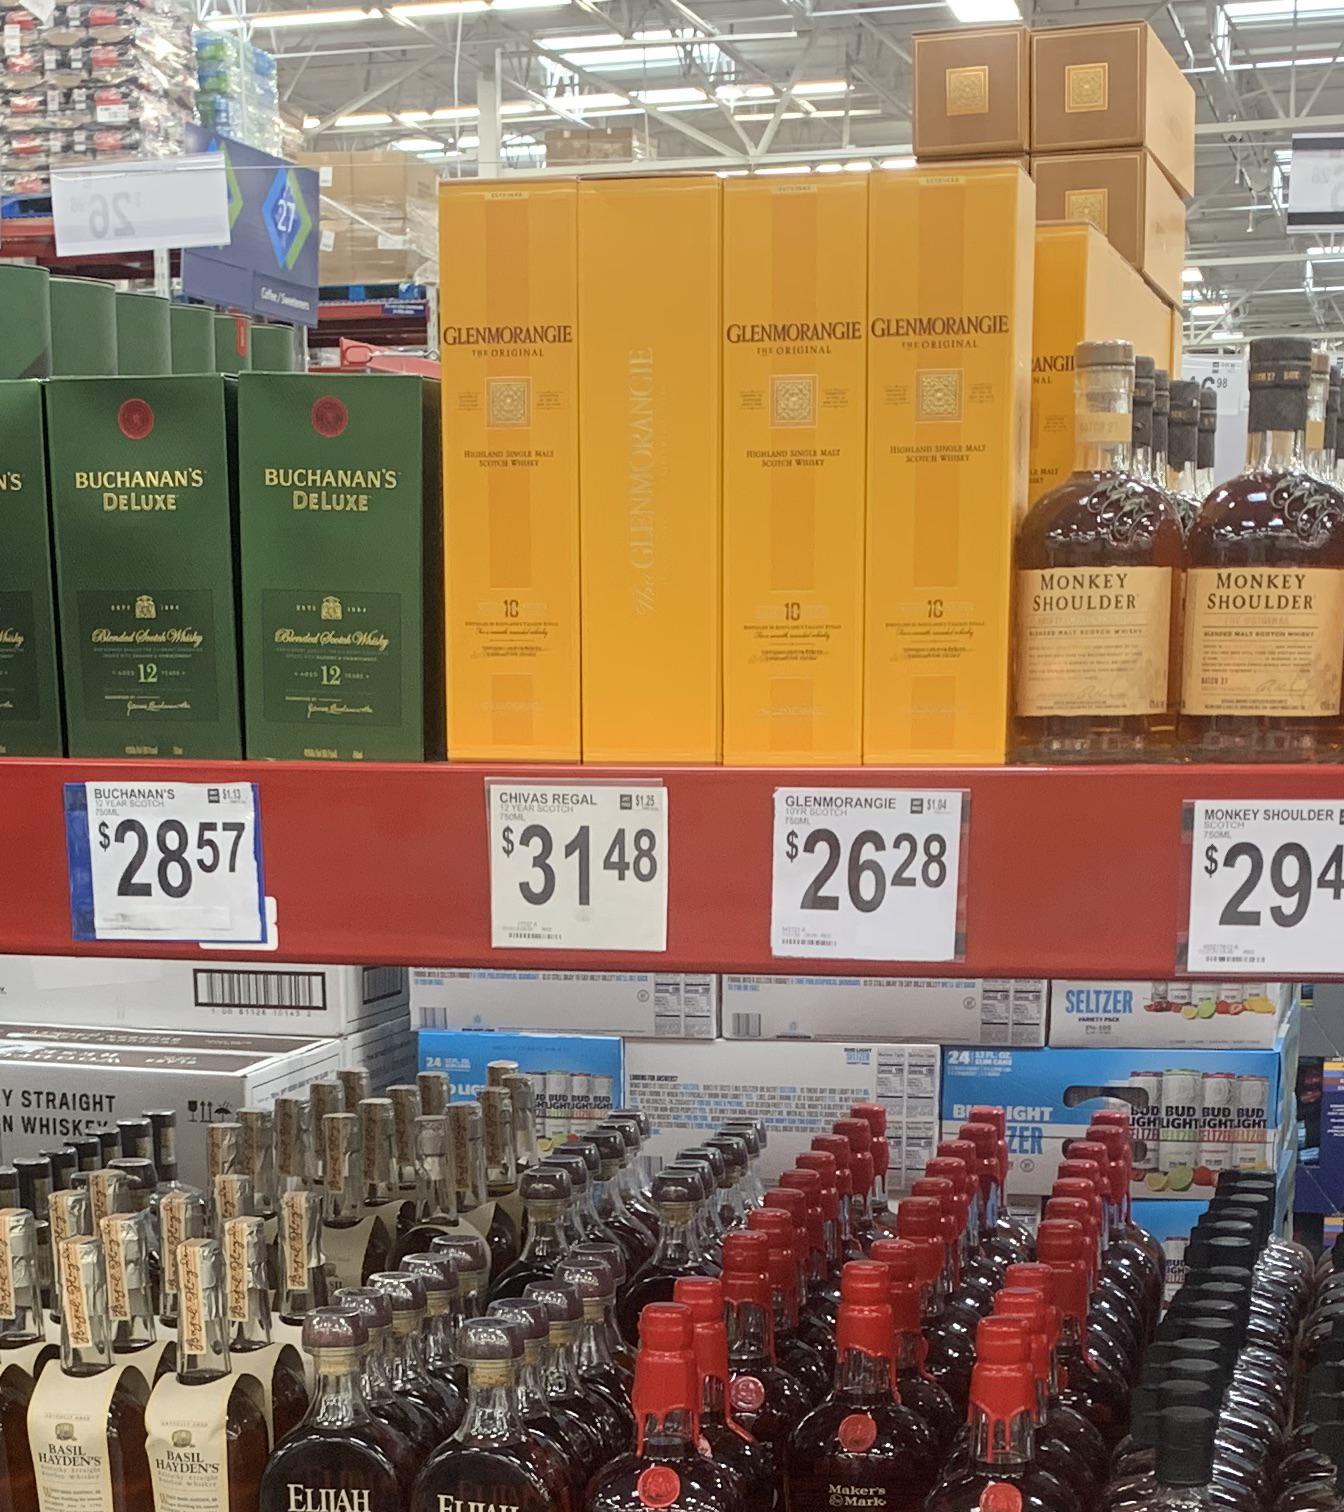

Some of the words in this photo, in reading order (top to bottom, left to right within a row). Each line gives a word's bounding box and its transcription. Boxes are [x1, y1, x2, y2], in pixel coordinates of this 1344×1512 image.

[277, 200, 296, 232] 27
[443, 326, 573, 346] GLENMORANGIE
[775, 346, 832, 356] ORIGINAL
[920, 339, 979, 350] ORIGINAL
[1040, 573, 1128, 591] MONKEY
[1032, 594, 1136, 612] SHOULDER
[94, 788, 175, 800] BUCHANAN'S
[500, 793, 548, 804] CHIVAS
[552, 794, 597, 806] REGAL
[785, 797, 896, 809] GLENMORANGIE
[1205, 809, 1260, 821] MONKEY
[1264, 809, 1334, 821] SHOULDER
[1065, 990, 1134, 1014] SELTZER
[21, 1090, 116, 1113] STRAIGHT
[48, 1444, 86, 1455] BASIL
[39, 1453, 101, 1466] HAYDEN'S
[167, 1450, 204, 1463] BASIL
